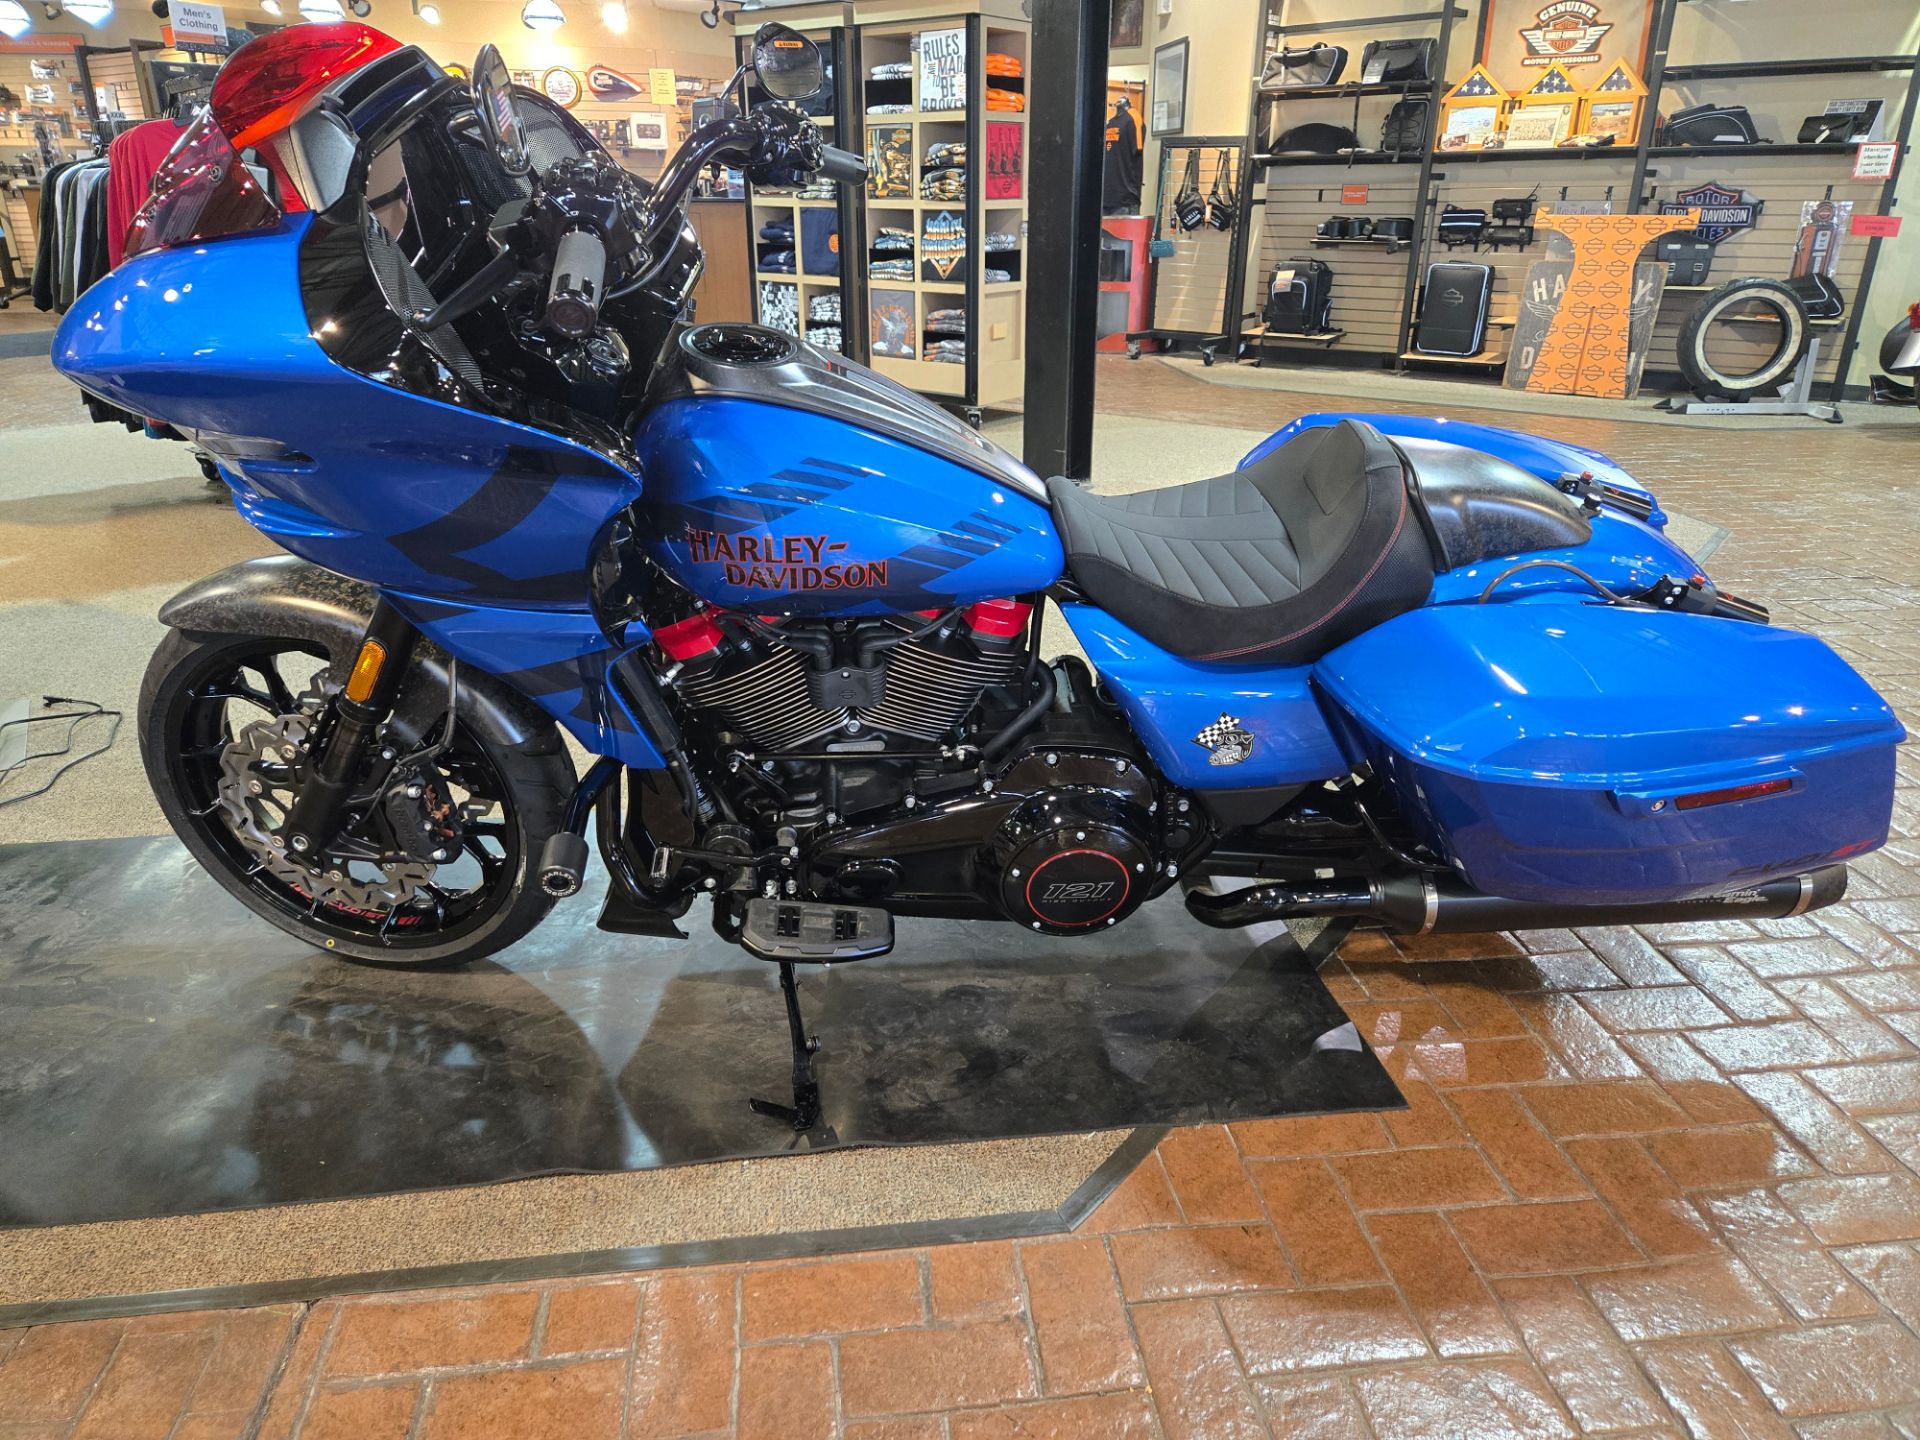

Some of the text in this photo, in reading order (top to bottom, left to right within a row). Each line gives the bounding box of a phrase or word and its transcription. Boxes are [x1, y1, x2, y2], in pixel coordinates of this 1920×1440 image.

[183, 8, 211, 19] Men's
[1539, 1, 1597, 20] GENUINE
[179, 18, 218, 32] Clothing
[923, 33, 960, 63] RULES
[1523, 57, 1549, 65] MOTOR
[940, 76, 956, 98] BE
[1701, 208, 1748, 223] DAVIDSON
[688, 528, 848, 565] HARLEY-
[724, 559, 888, 591] DAVIDSON
[1043, 881, 1115, 899] 121
